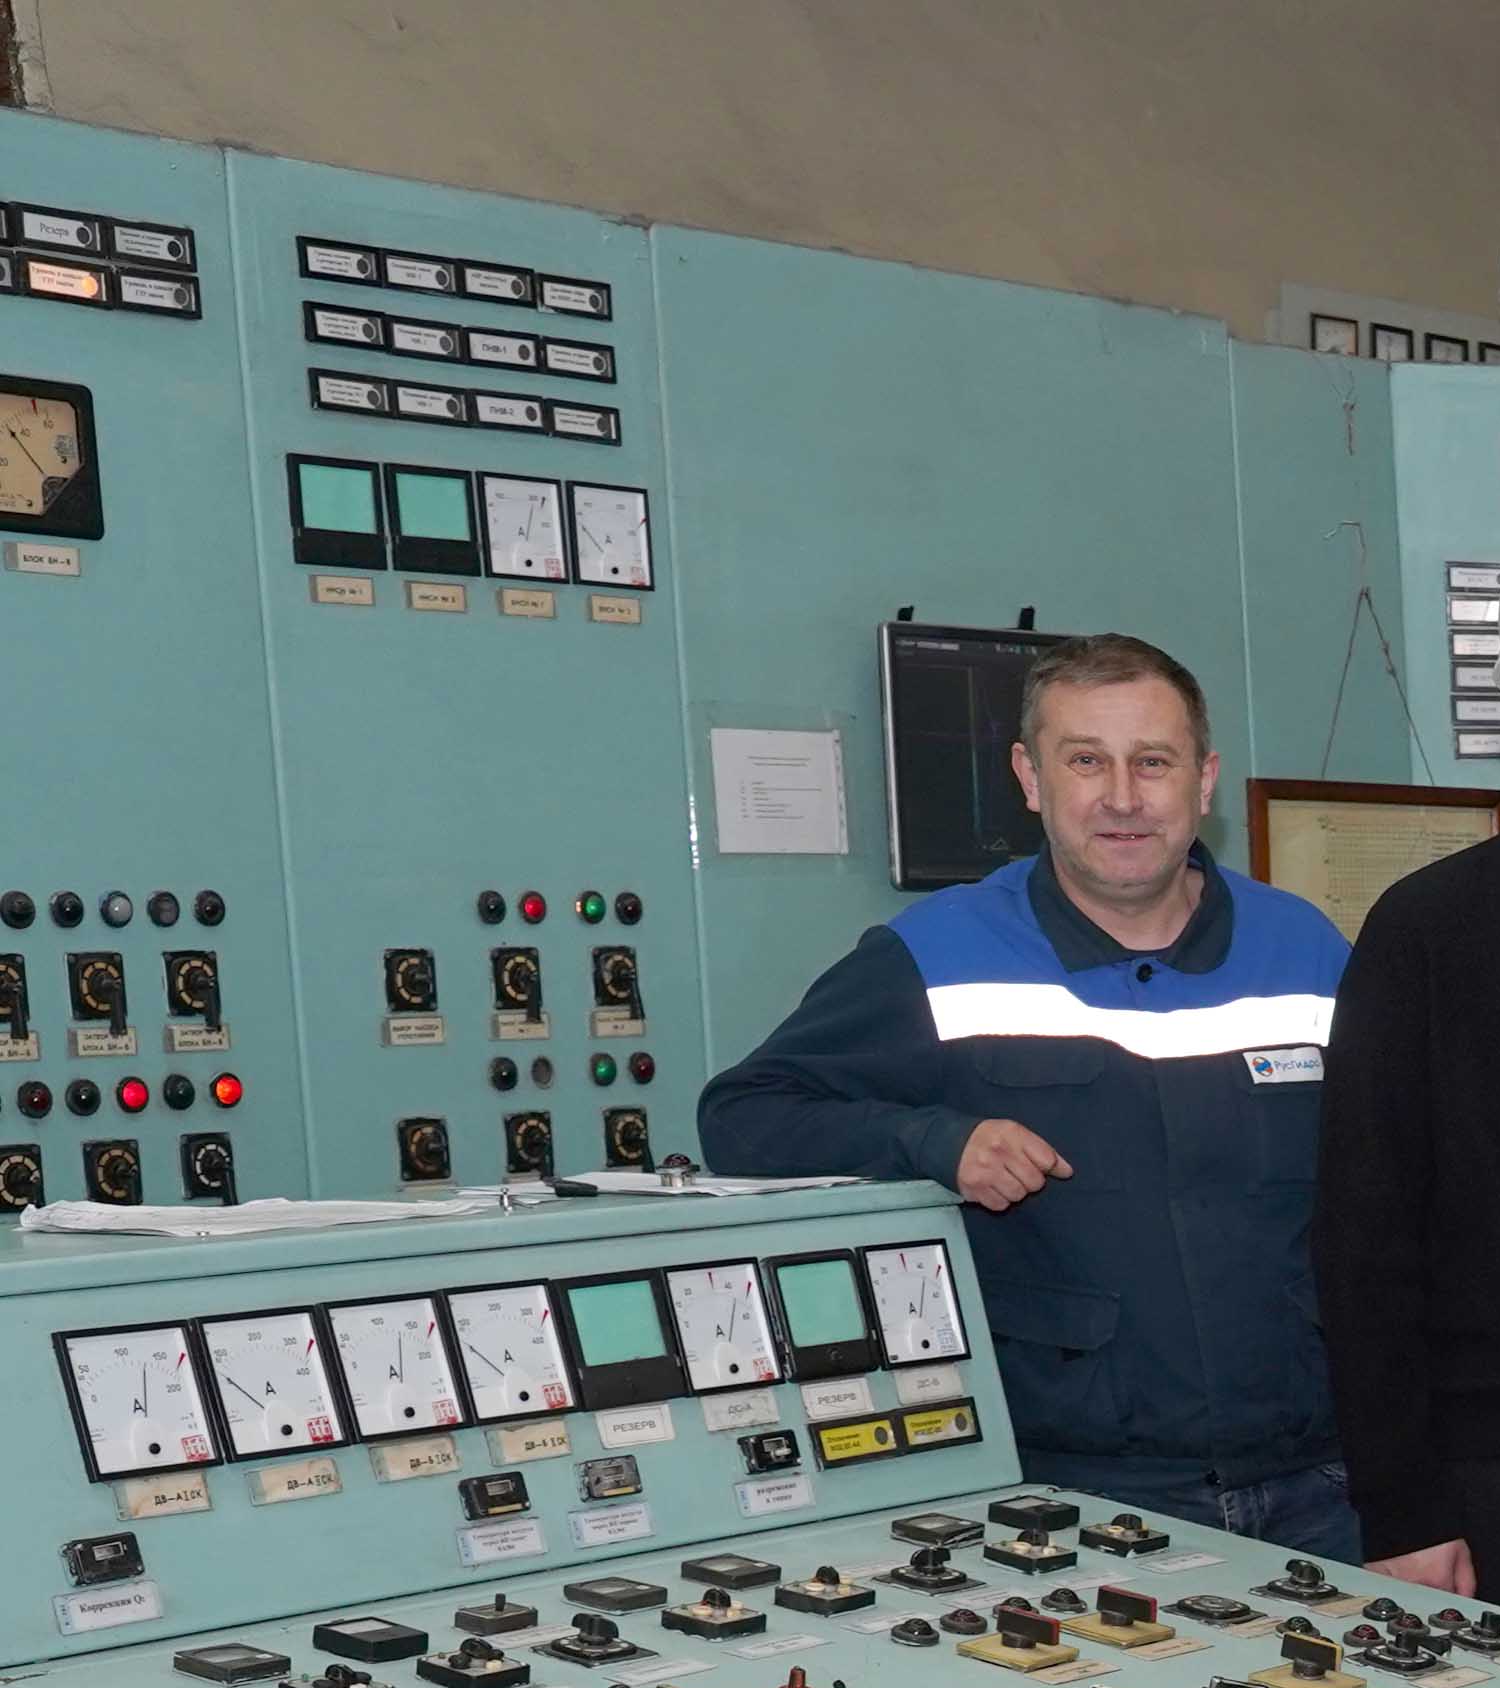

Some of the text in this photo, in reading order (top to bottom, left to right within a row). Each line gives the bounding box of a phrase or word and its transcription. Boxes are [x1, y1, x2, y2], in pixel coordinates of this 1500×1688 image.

[909, 1302, 917, 1315] A
[404, 1321, 418, 1330] 150
[716, 1324, 725, 1337] A
[247, 1331, 262, 1341] 200
[283, 1337, 298, 1346] 300
[339, 1333, 350, 1343] 50
[114, 1347, 129, 1357] 100
[152, 1351, 168, 1361] 150
[503, 1349, 515, 1363] A
[388, 1365, 401, 1379] A
[166, 1383, 182, 1393] 200
[265, 1381, 277, 1396] A
[817, 1391, 857, 1406] РЕЗЕРВ
[133, 1398, 146, 1414] A
[612, 1420, 657, 1433] РЕЗЕРВ
